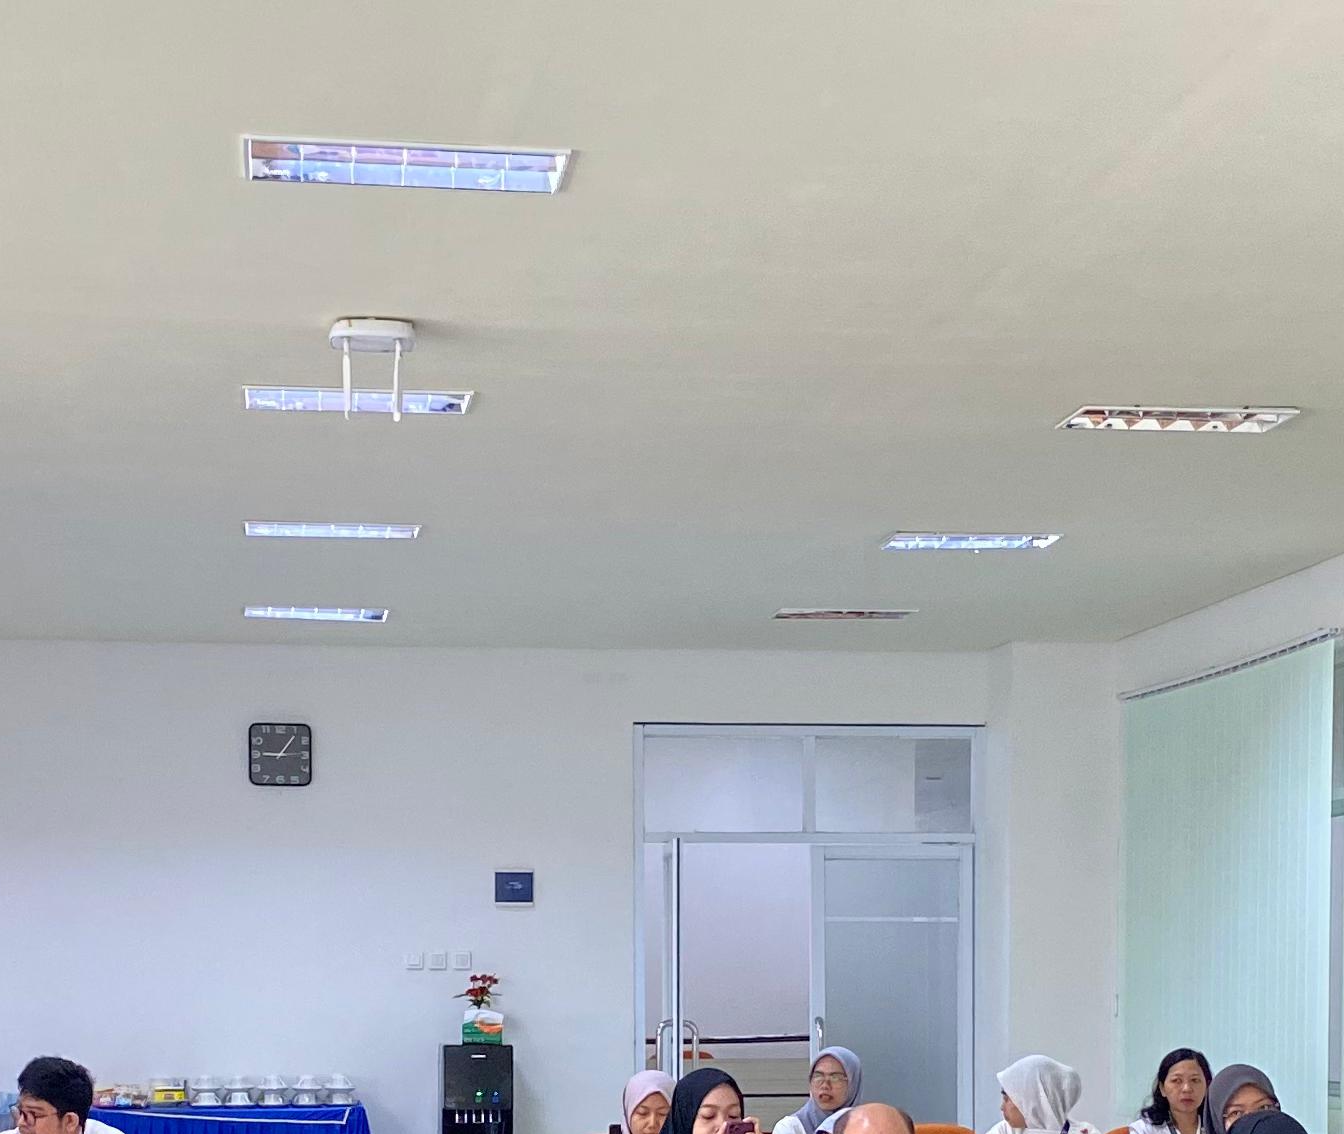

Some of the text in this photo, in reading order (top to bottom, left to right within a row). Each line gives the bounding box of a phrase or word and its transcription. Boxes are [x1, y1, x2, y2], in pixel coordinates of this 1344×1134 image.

[261, 725, 271, 734] 11
[275, 725, 287, 734] 12
[251, 736, 263, 746] 10
[301, 736, 310, 746] 2
[251, 750, 261, 759] 9
[300, 750, 310, 760] 3
[262, 774, 271, 784] 7
[275, 775, 285, 785] 6
[290, 775, 300, 785] 5
